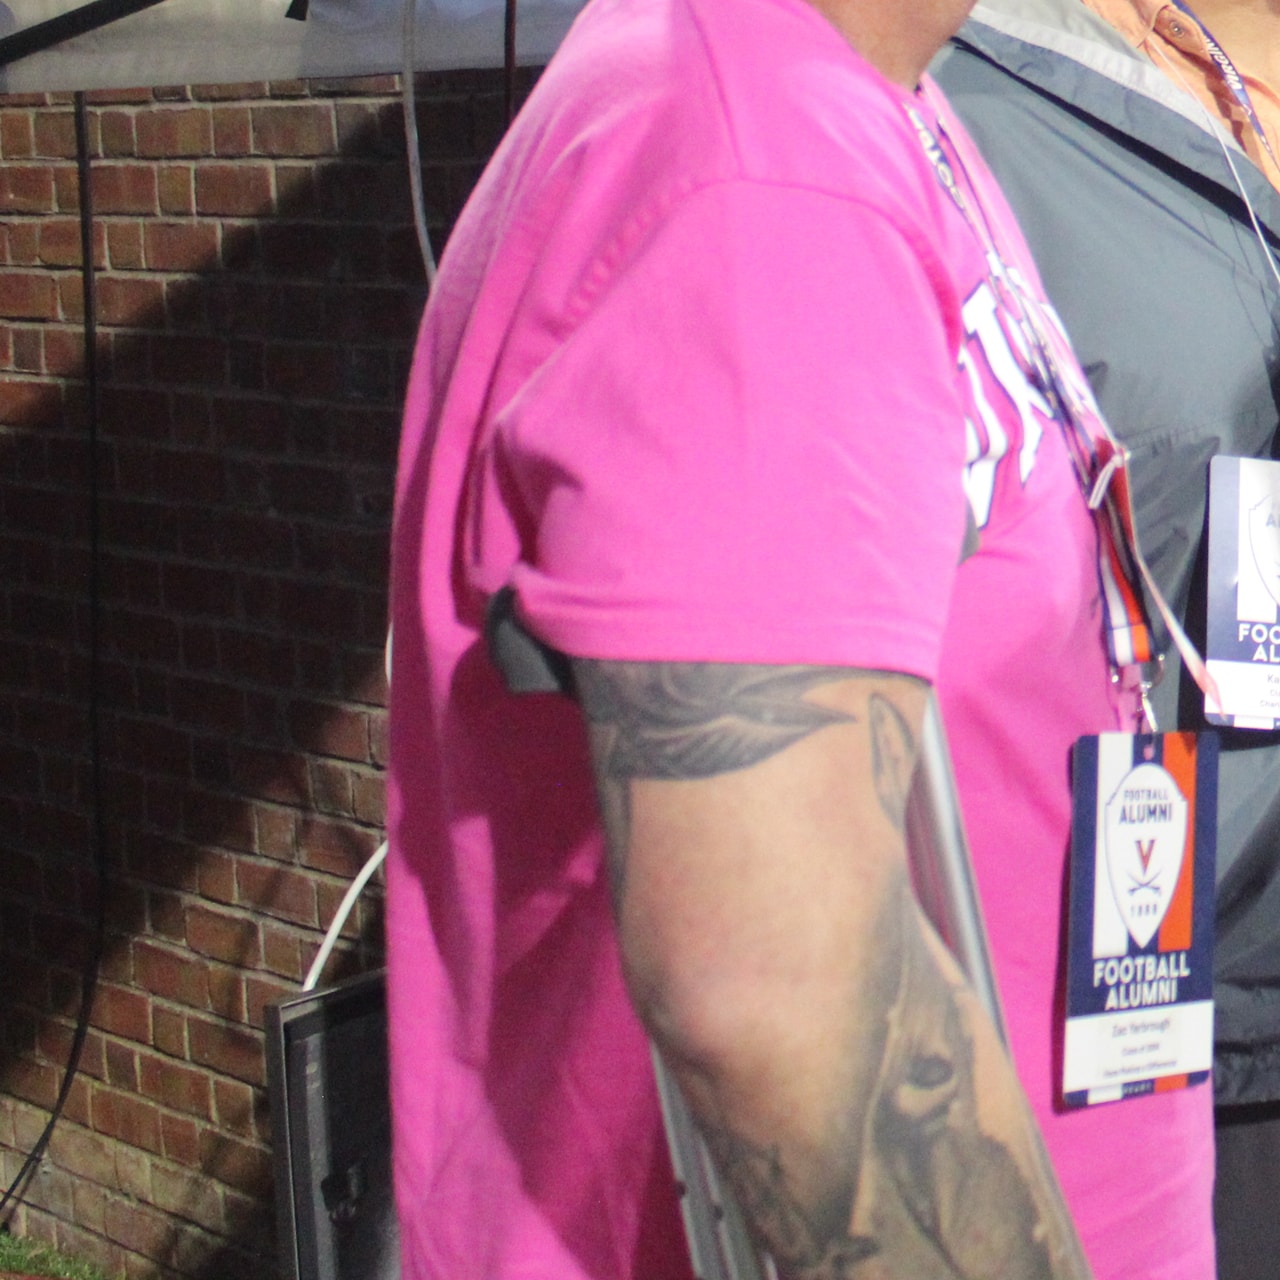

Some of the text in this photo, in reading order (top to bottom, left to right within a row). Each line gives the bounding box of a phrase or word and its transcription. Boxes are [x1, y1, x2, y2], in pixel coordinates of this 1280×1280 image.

[1124, 789, 1169, 801] FOOTBALL
[1119, 803, 1173, 824] ALUMNI
[1093, 951, 1191, 987] FOOTBALL
[1104, 979, 1178, 1010] ALUMNI
